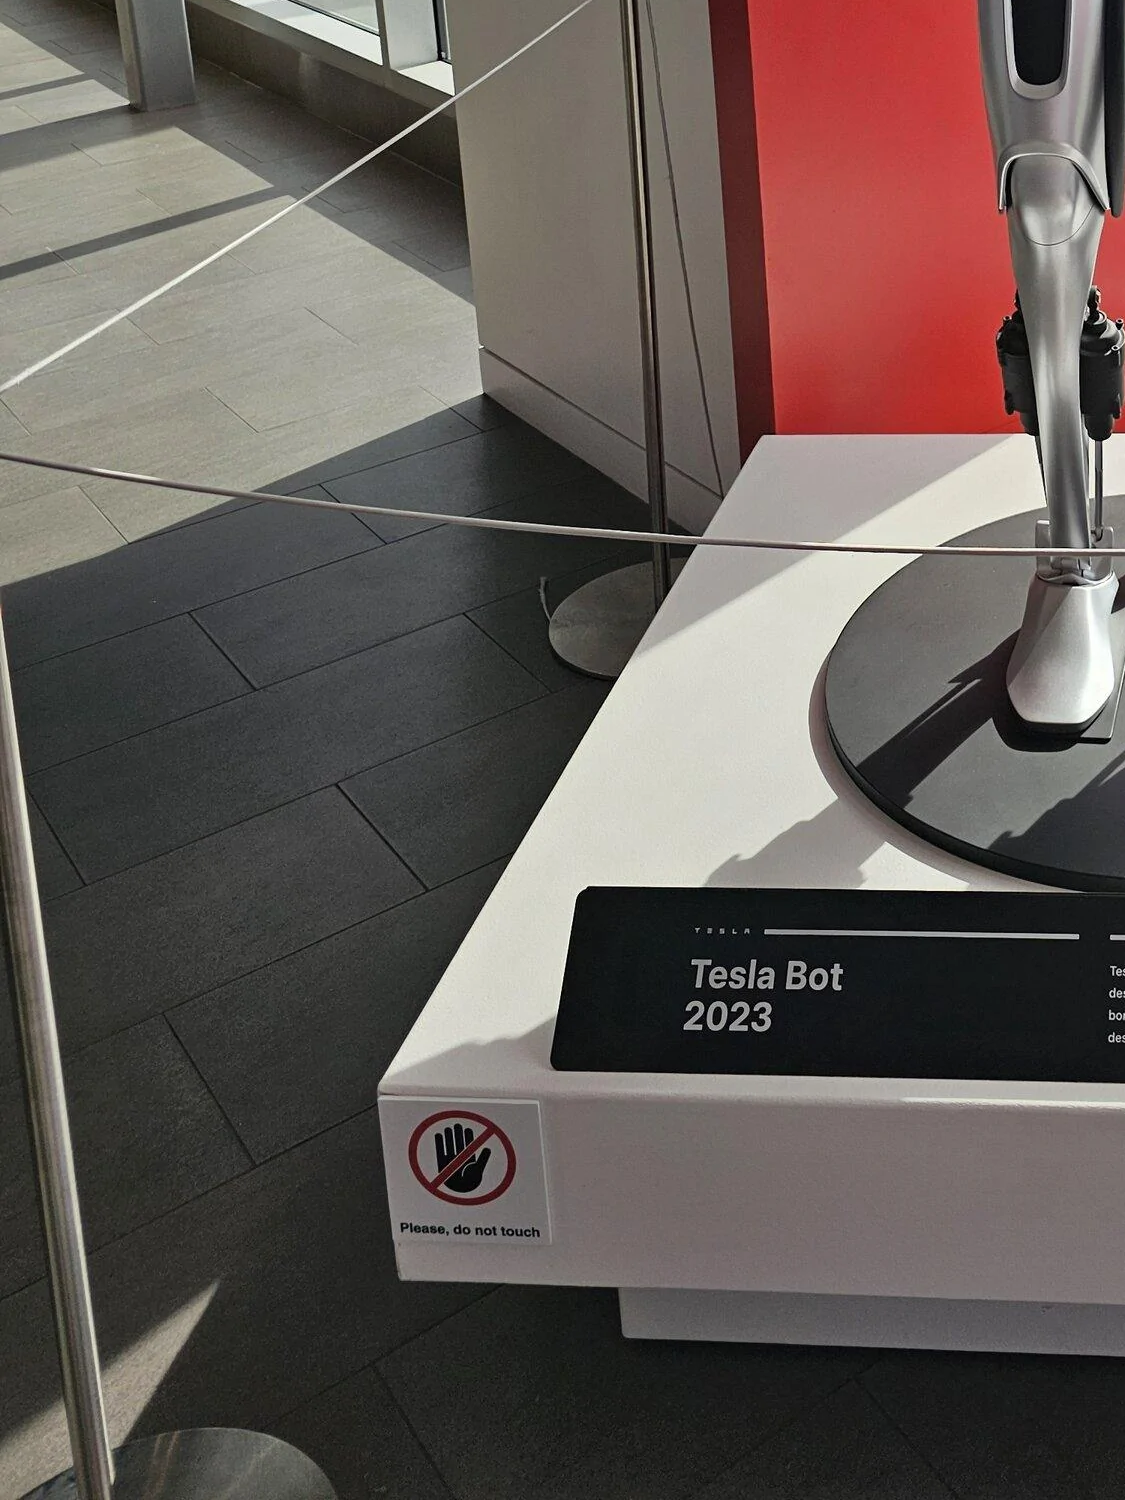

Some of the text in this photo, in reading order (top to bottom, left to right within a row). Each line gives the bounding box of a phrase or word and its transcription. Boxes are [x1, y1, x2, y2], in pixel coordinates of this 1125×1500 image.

[694, 927, 751, 935] TESLA
[690, 958, 844, 992] Tesla Bot
[682, 1000, 773, 1033] 2023
[400, 1222, 541, 1238] Please, do not touch
